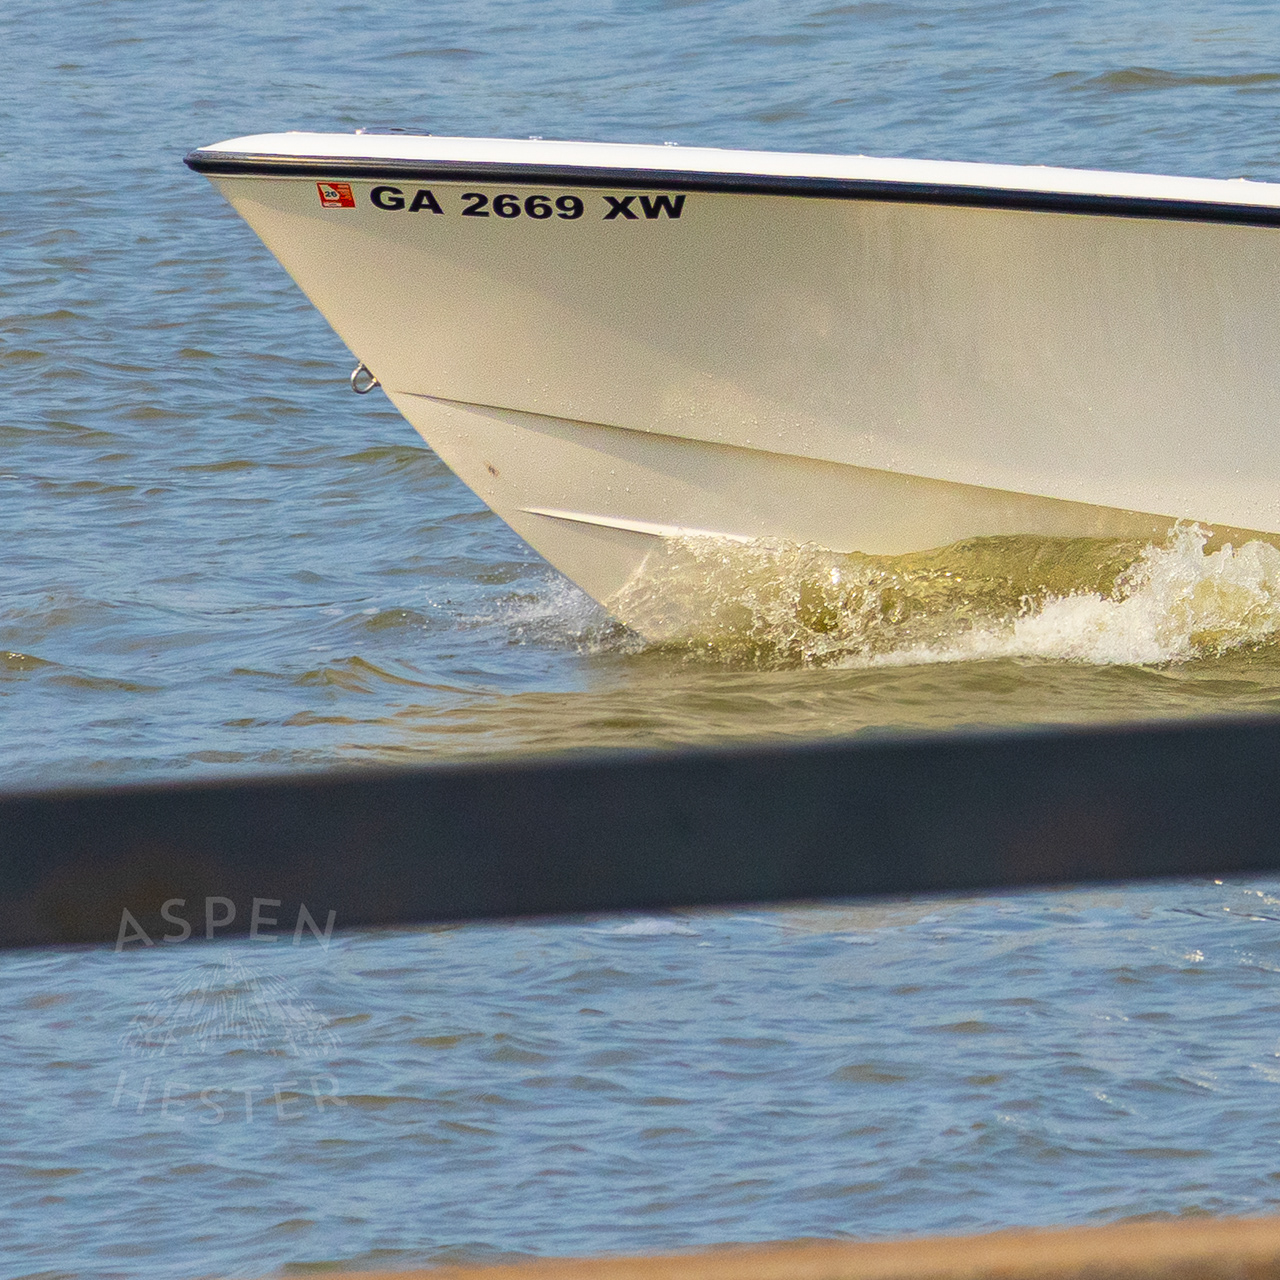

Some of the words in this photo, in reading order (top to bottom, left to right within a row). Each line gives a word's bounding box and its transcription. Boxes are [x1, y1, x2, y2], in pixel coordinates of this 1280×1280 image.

[369, 186, 445, 215] GA
[461, 192, 585, 220] 2669
[602, 194, 687, 220] XW
